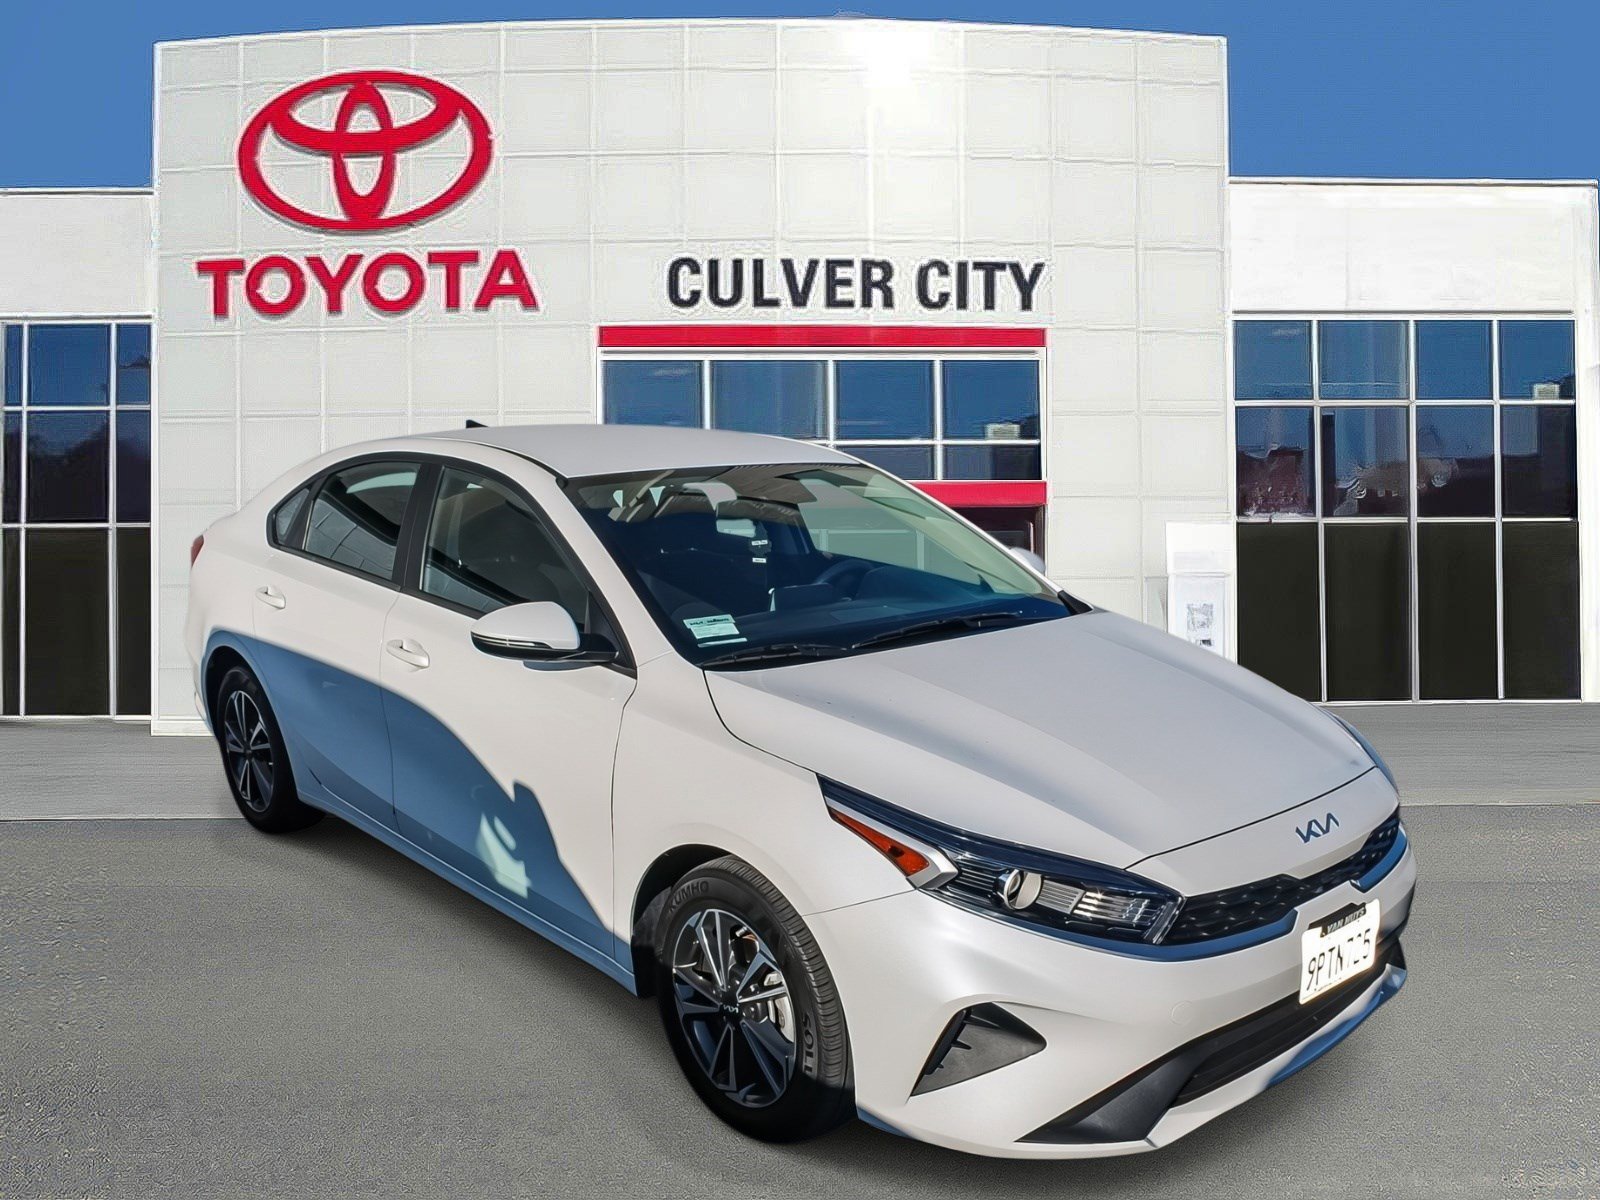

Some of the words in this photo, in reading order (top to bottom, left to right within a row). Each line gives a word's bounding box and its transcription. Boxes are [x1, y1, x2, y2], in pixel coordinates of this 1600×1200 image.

[196, 249, 540, 320] TOYOTA
[667, 256, 895, 310] CULVER
[916, 258, 1046, 312] CITY
